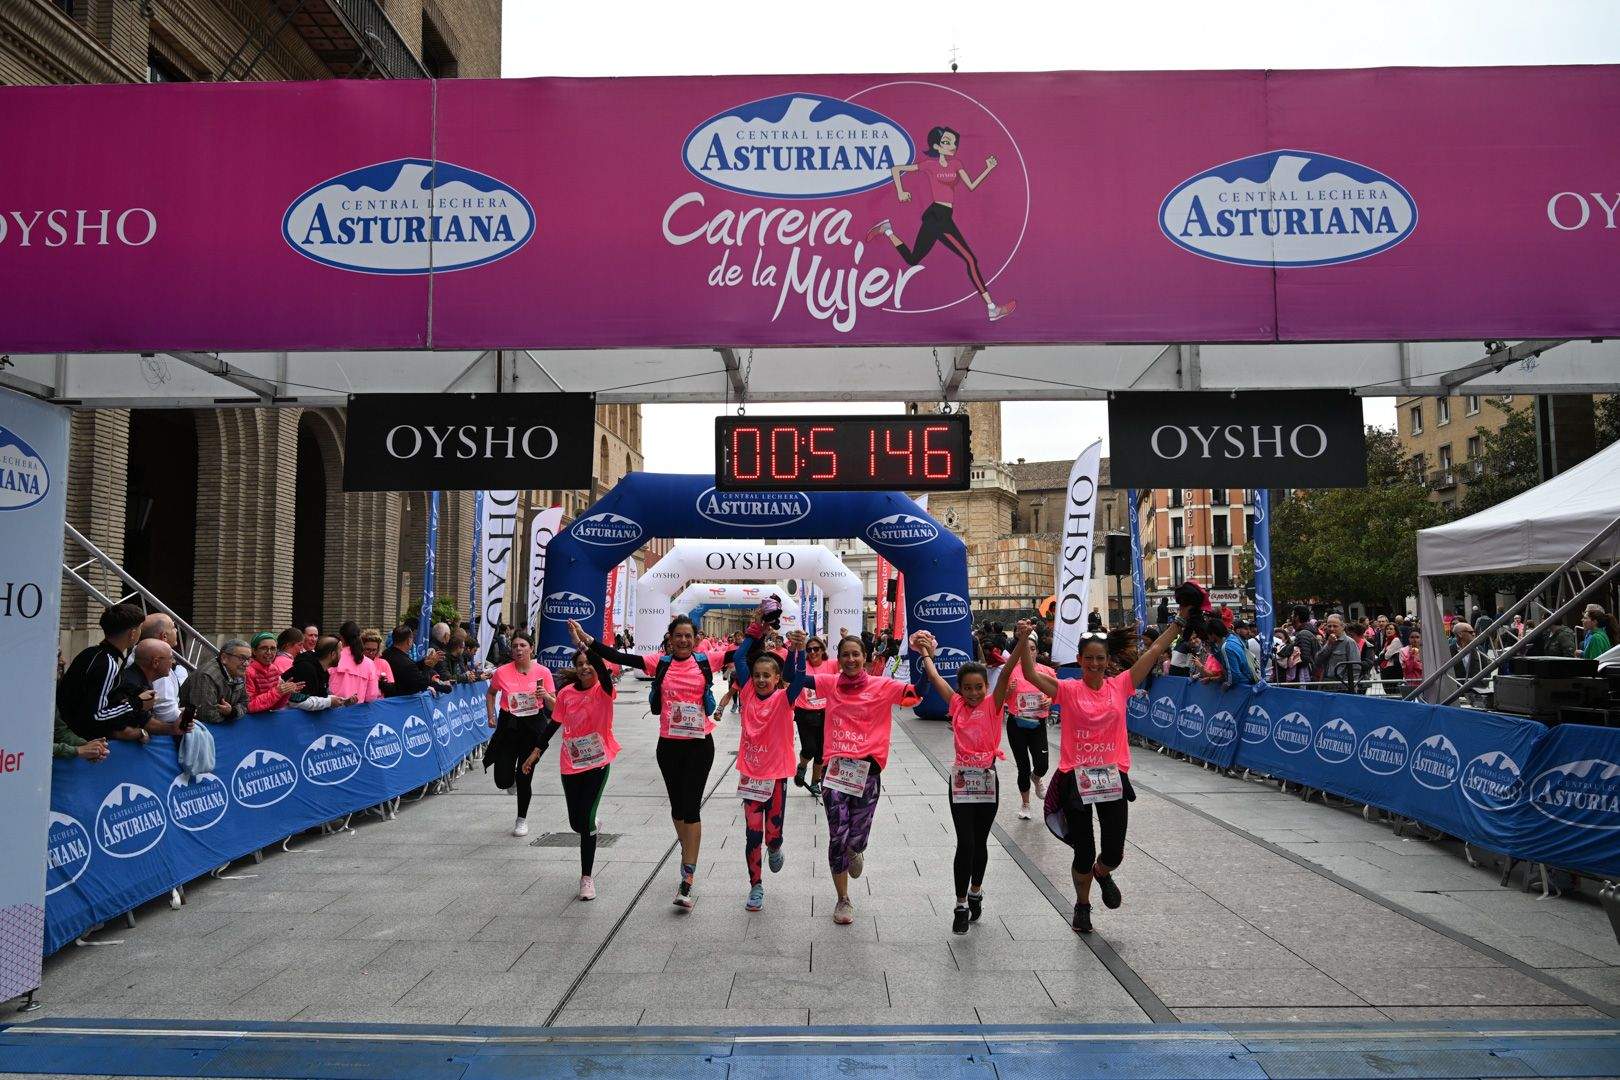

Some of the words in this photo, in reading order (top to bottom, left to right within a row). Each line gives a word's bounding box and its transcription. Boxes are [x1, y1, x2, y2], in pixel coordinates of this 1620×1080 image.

[736, 130, 809, 140] CENTRAL
[816, 129, 889, 140] LECHERA
[700, 132, 896, 171] ASTURIANA
[341, 198, 419, 211] CENTRAL
[428, 197, 508, 209] LECHERA
[1218, 190, 1298, 203] CENTRAL
[1306, 189, 1388, 201] LECHERA
[301, 203, 516, 245] ASTURIANA
[661, 191, 852, 246] Carrera
[1179, 195, 1399, 237] ASTURIANA
[0, 208, 157, 247] YSHO
[708, 250, 743, 287] de
[751, 250, 776, 287] la
[771, 240, 925, 333] Mujer
[385, 424, 559, 459] OYSHO
[1151, 423, 1328, 459] OYSHO
[705, 494, 803, 515] ASTURIANA
[575, 524, 637, 538] ASTURIANA
[872, 527, 934, 539] ASTURIANA
[705, 552, 795, 570] OYSHO
[1060, 475, 1095, 626] OYSHO
[917, 605, 967, 617] ASTURIANA
[682, 715, 696, 723] 016
[407, 732, 431, 748] ASTURIANA
[832, 730, 868, 742] DORSAL
[1076, 729, 1090, 739] TU
[1275, 724, 1308, 745] ASTURIANA
[1316, 732, 1352, 755] ASTURIANA
[369, 742, 401, 761] ASTURIANA
[1076, 742, 1117, 753] DORSAL
[1361, 740, 1404, 766] ASTURIANA
[0, 748, 25, 774] er
[307, 752, 359, 778] ASTURIANA
[1075, 755, 1105, 765] SUMA
[840, 769, 854, 778] 016
[238, 769, 295, 800] ASTURIANA
[174, 792, 226, 820] ASTURIANA
[103, 809, 165, 848] ASTURIANA
